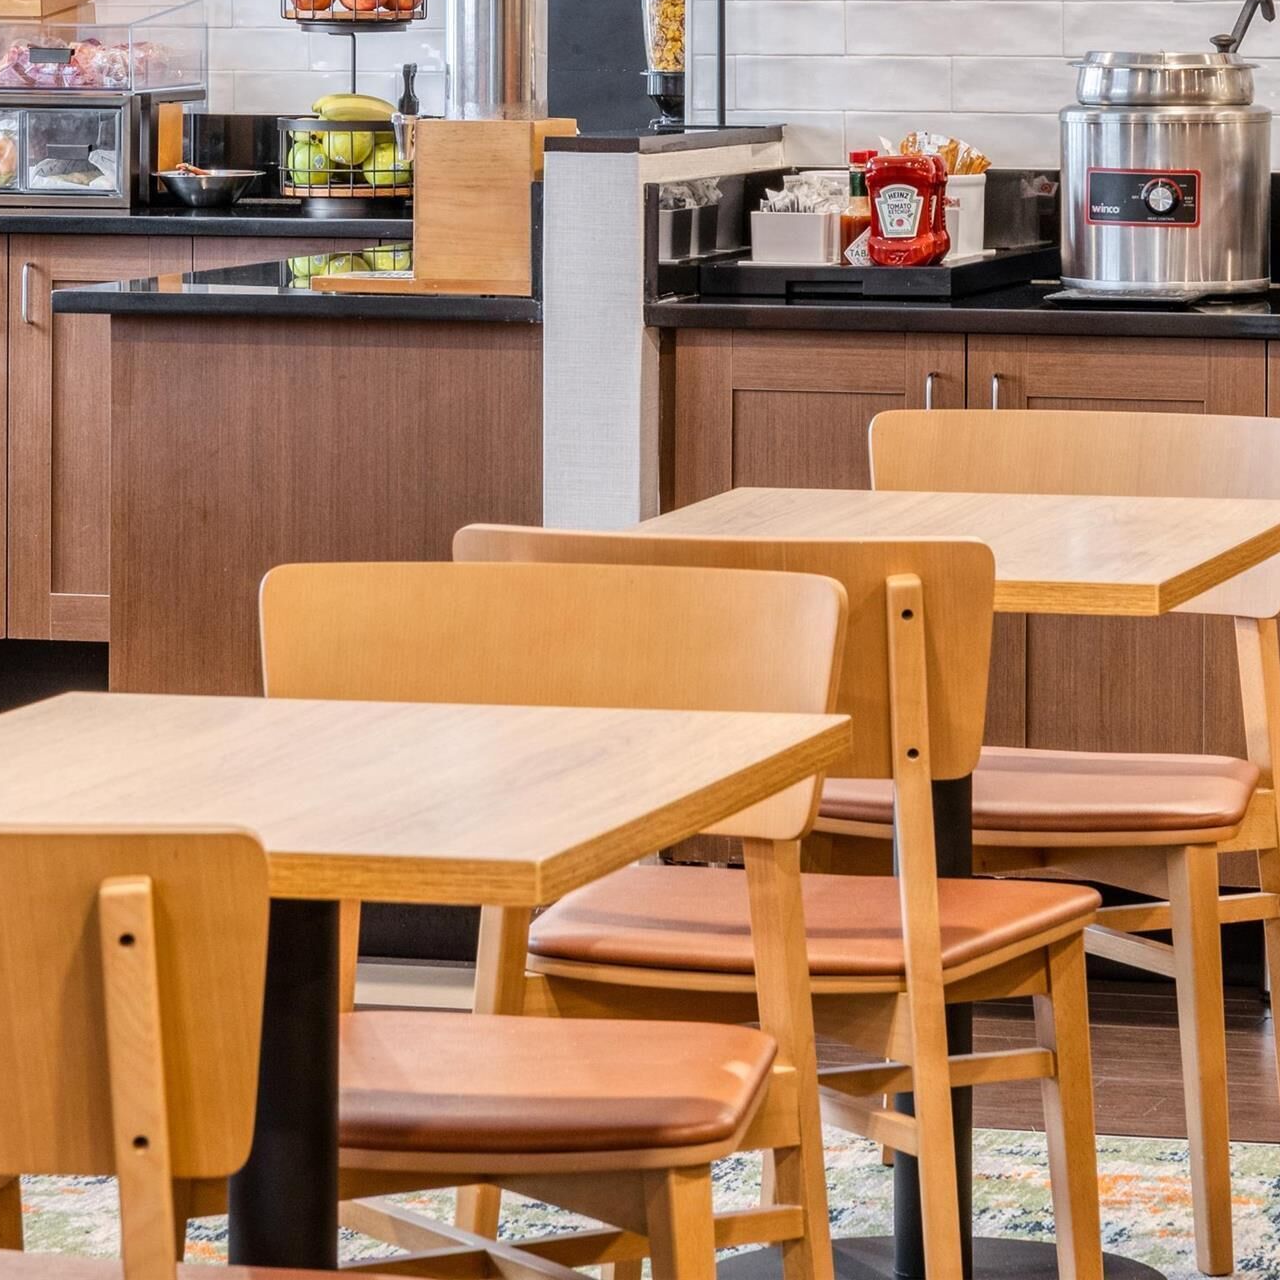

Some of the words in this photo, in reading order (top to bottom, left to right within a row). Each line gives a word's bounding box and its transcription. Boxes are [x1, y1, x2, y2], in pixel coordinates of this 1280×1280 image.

[888, 192, 909, 200] HEINZ
[1091, 202, 1120, 214] winco
[849, 248, 869, 258] TAB
